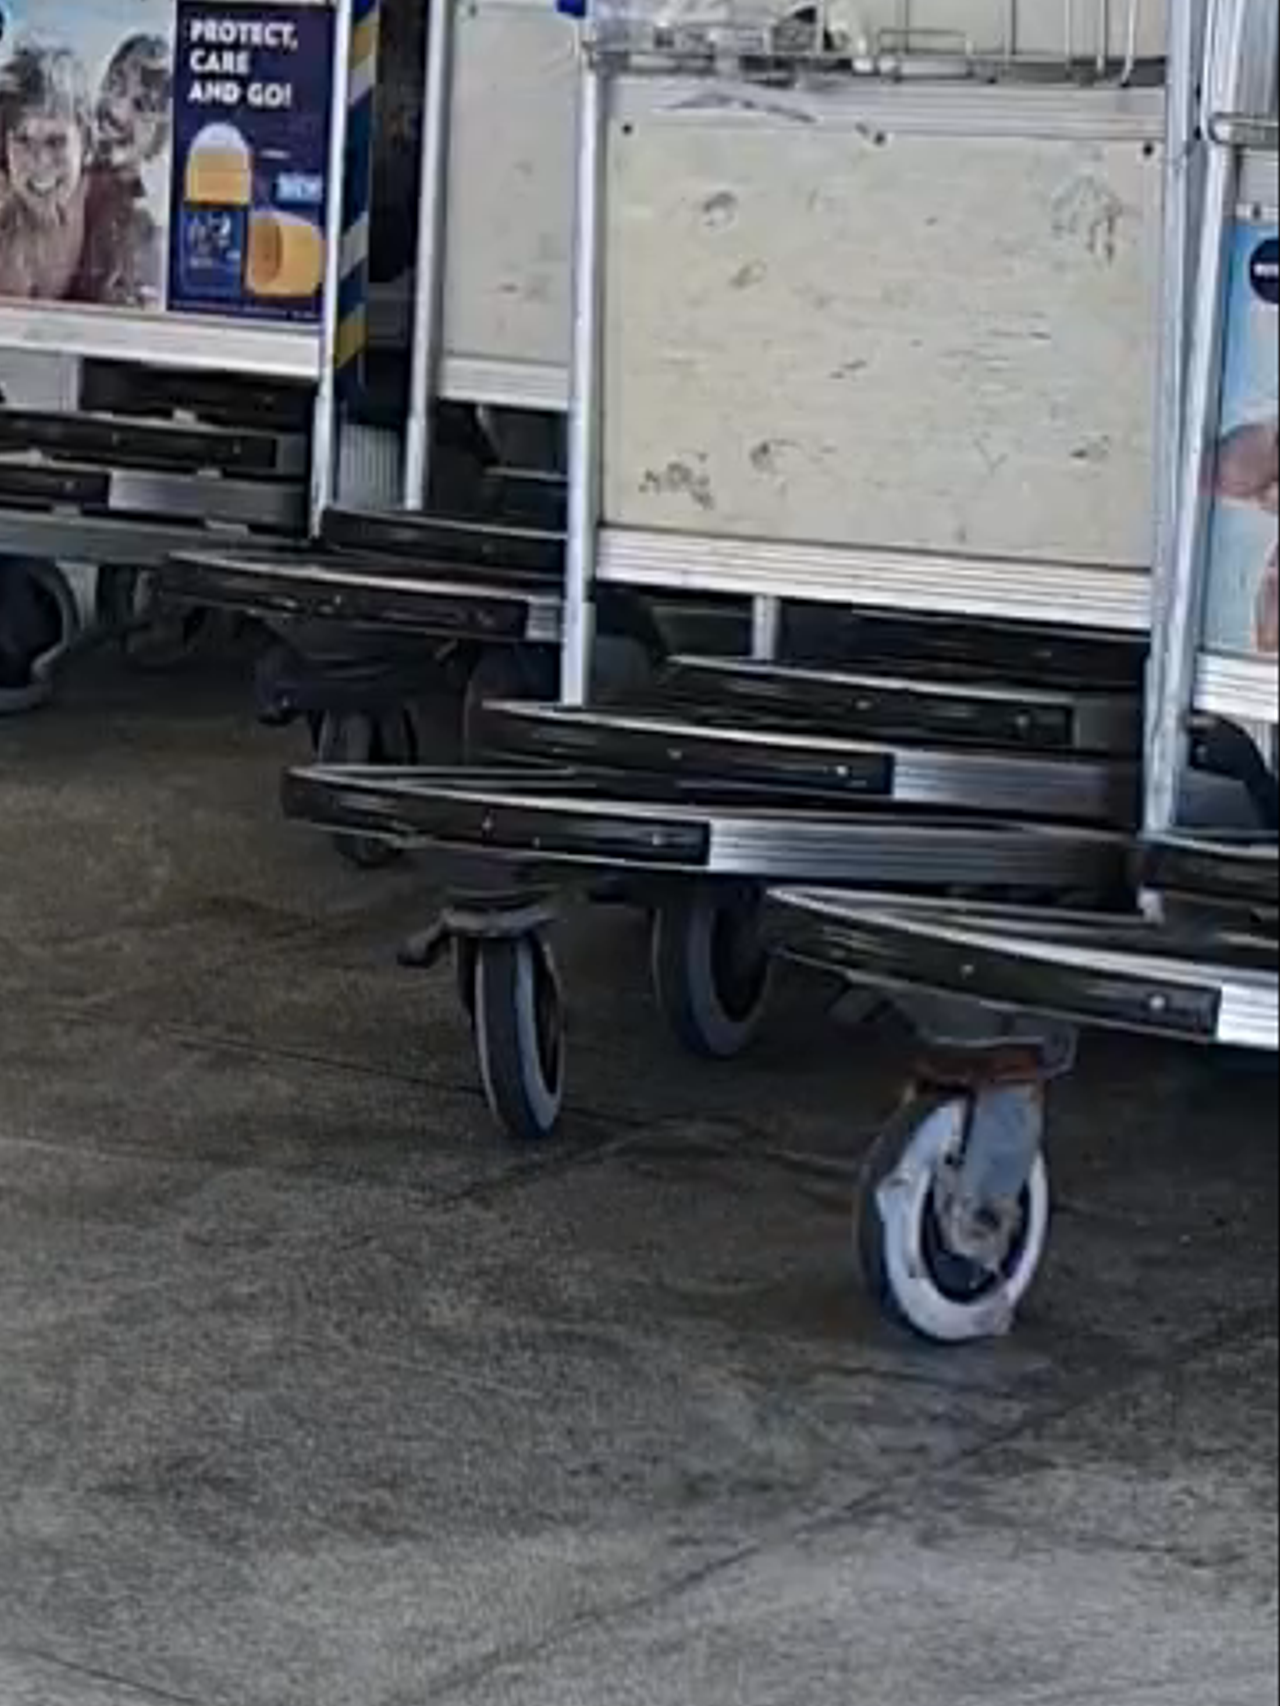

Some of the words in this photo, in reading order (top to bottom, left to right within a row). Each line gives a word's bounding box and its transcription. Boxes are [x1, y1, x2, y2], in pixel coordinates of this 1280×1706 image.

[190, 19, 298, 50] PROTECT,
[190, 48, 250, 74] CARE
[188, 81, 240, 105] AND
[246, 82, 293, 107] GO!
